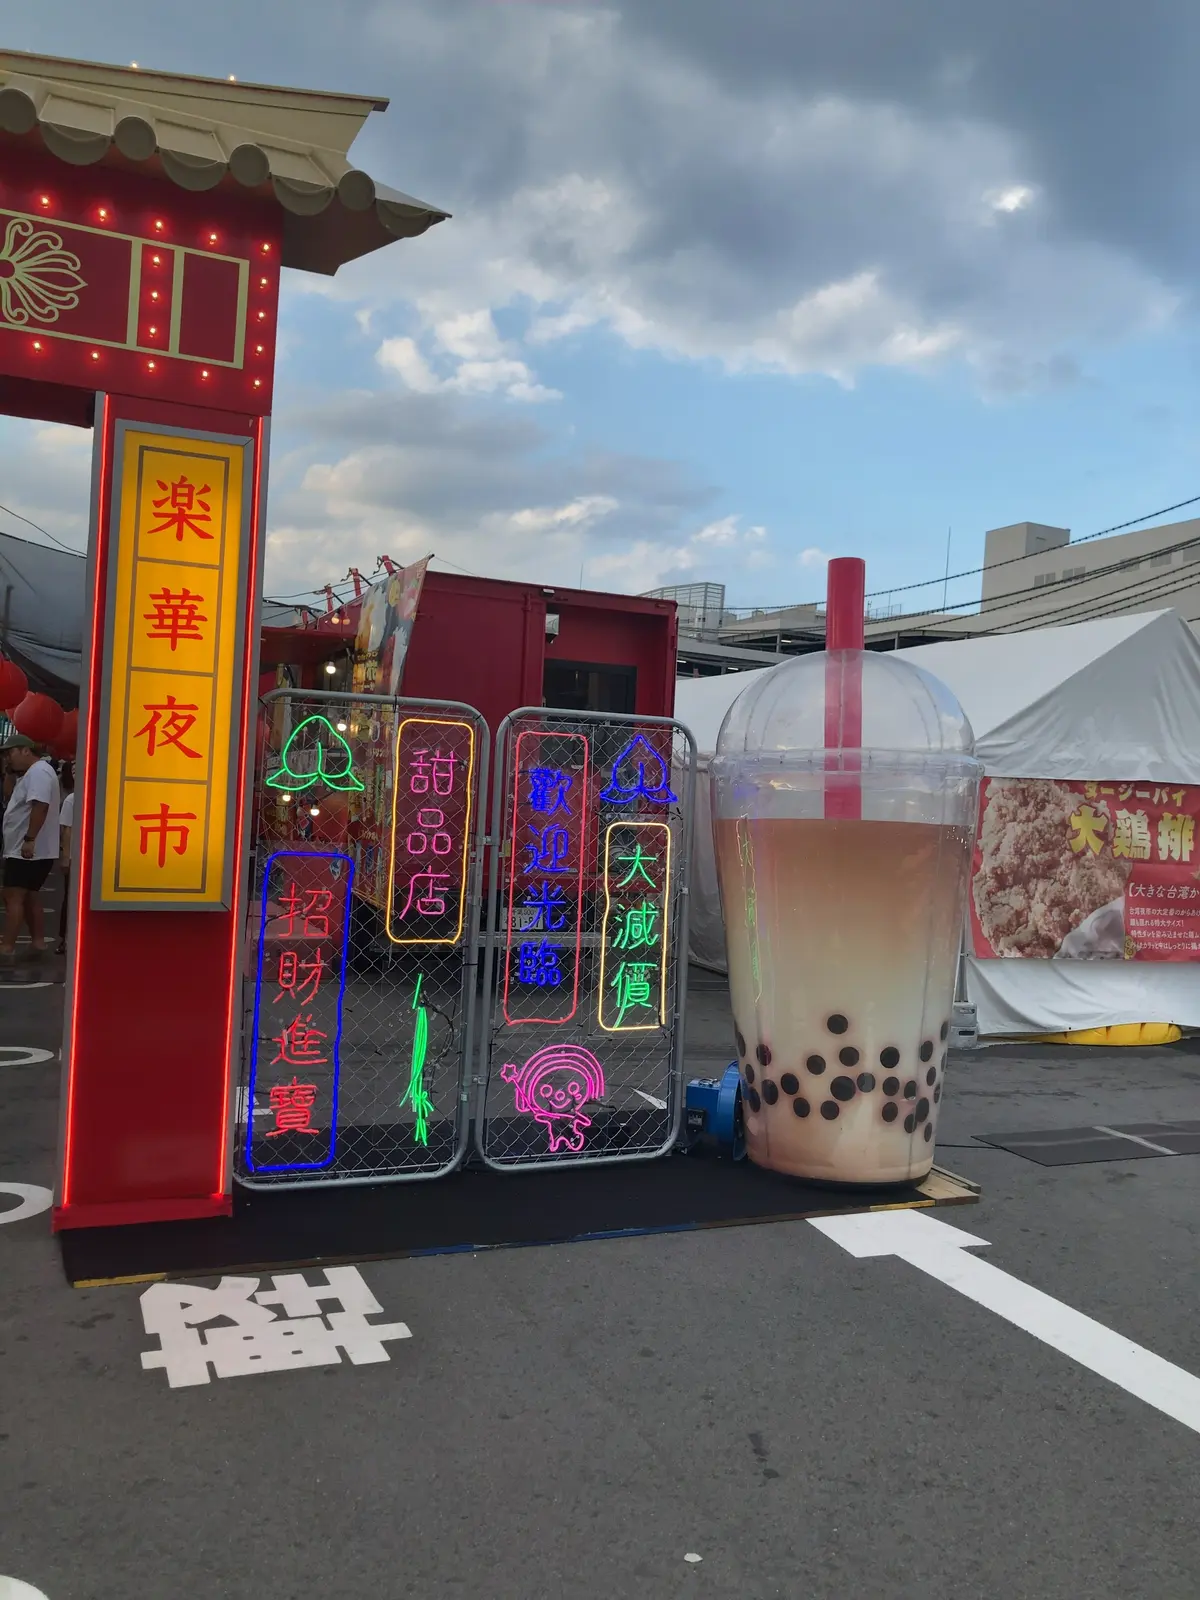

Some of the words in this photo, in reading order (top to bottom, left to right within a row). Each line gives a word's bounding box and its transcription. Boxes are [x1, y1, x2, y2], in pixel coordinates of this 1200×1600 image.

[133, 475, 214, 868] 楽華夜市
[401, 747, 458, 919] 甜品店
[518, 766, 570, 988] 歡迎光臨
[612, 844, 658, 1028] 大減價
[269, 883, 332, 1137] 招財進寶
